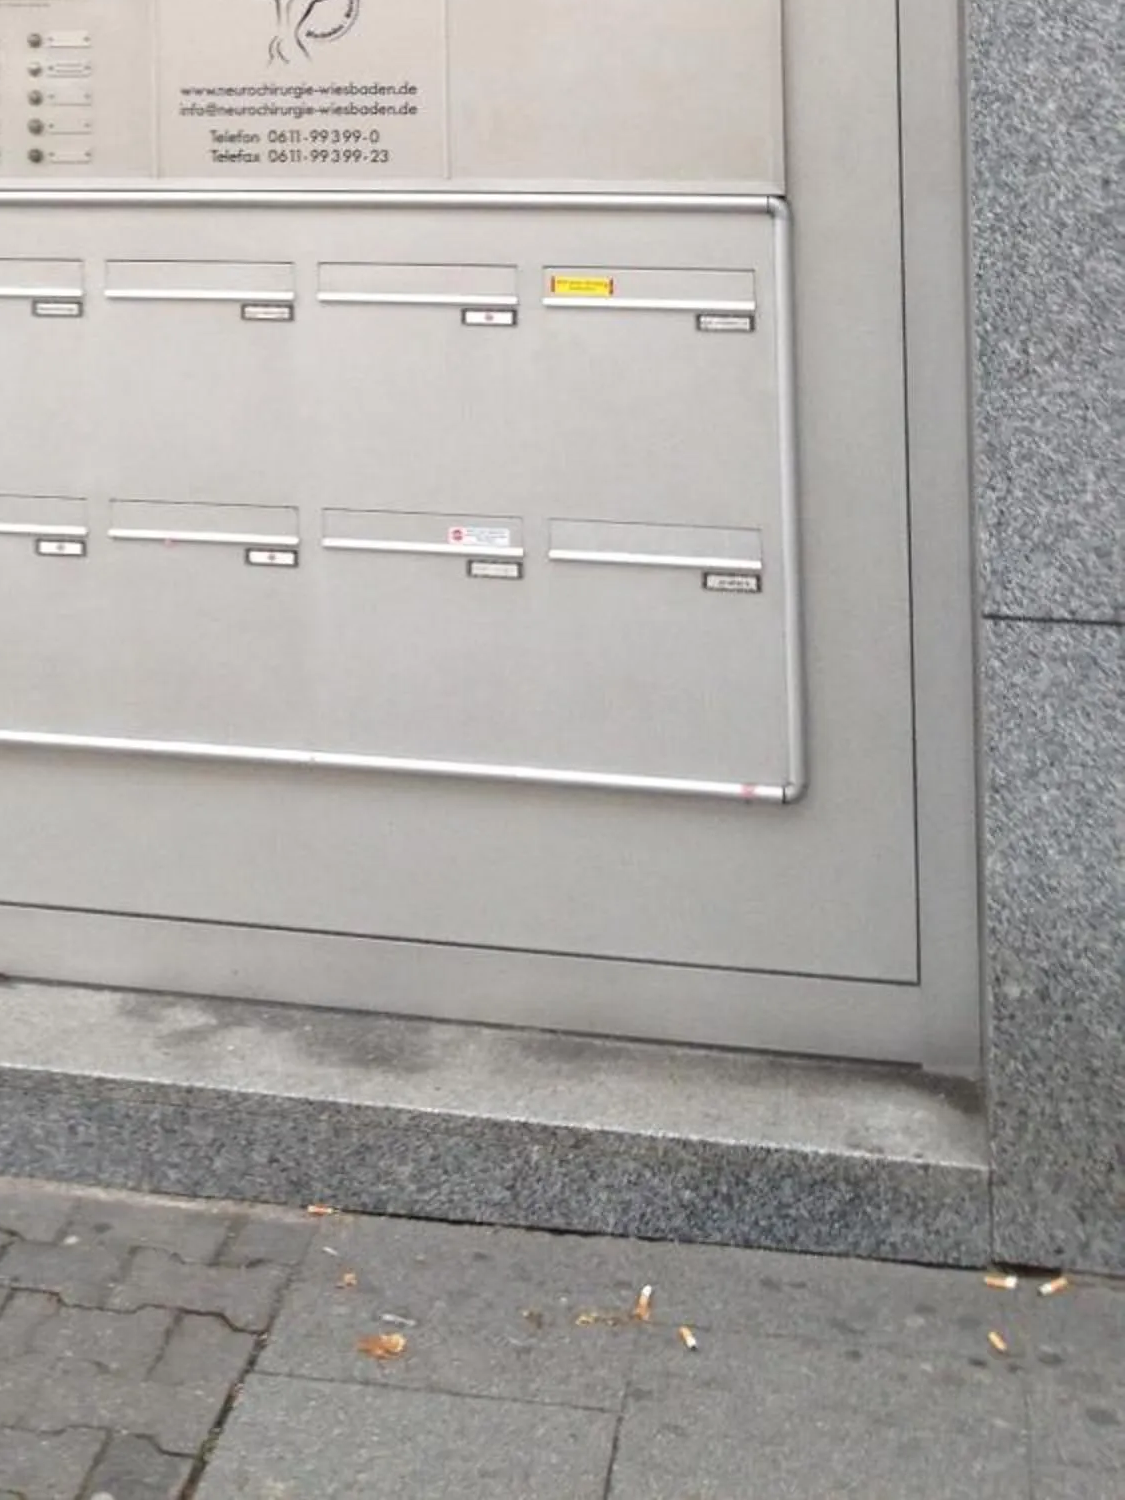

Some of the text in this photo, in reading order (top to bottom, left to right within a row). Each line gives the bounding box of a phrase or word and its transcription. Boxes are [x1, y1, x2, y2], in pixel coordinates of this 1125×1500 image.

[180, 81, 418, 99] www.neurochirurgie-wiesbaden.de
[179, 100, 418, 118] info@neurochirurgie-wiesbaden.de
[209, 129, 261, 144] Telefon
[209, 149, 261, 164] Telefax
